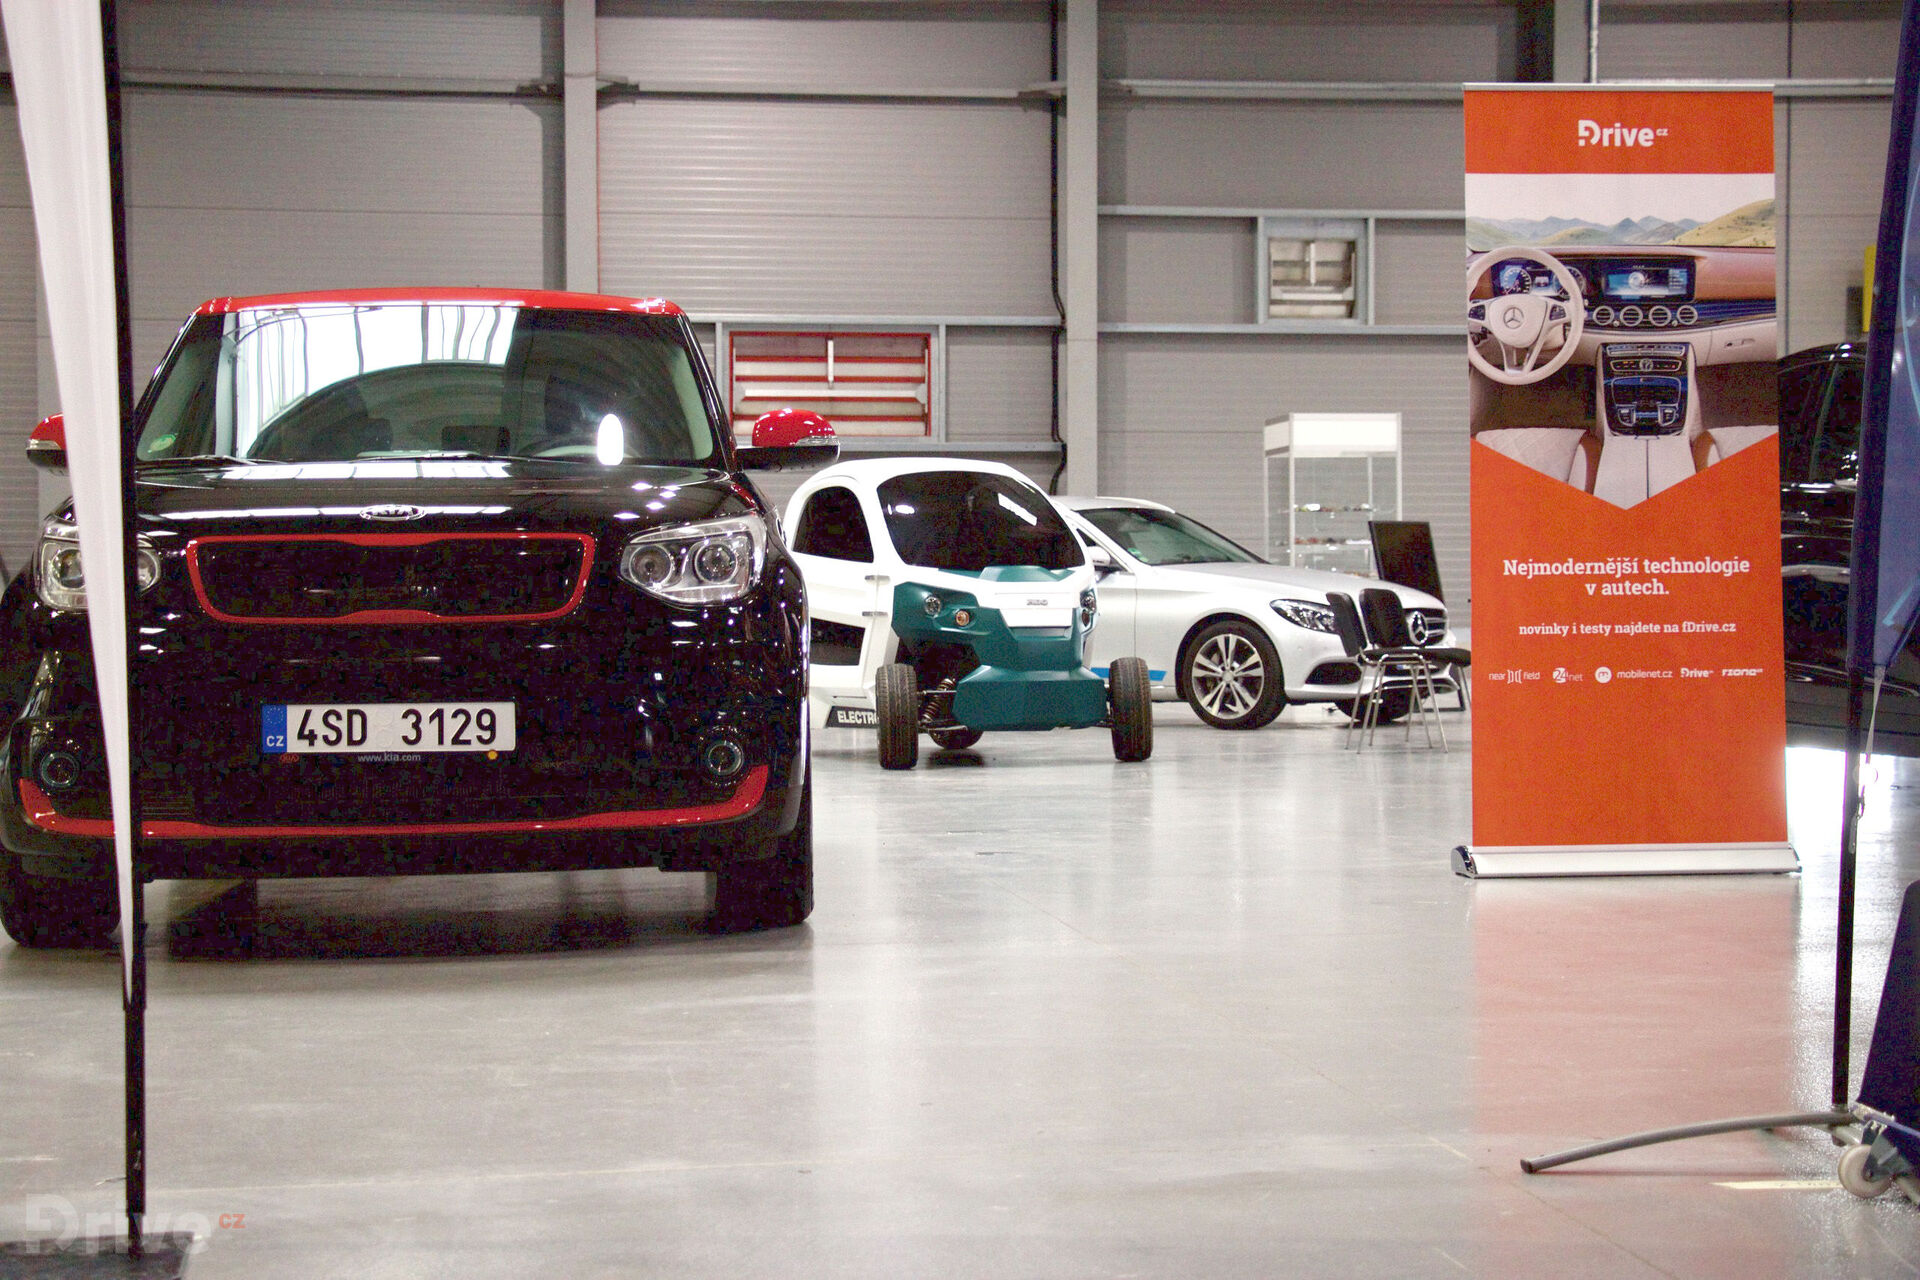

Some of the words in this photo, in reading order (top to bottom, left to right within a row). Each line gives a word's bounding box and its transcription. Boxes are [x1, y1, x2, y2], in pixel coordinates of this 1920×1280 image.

[1503, 557, 1639, 579] Nejmodernější
[1643, 556, 1750, 577] technologie
[1585, 583, 1597, 596] v
[1601, 578, 1669, 596] autech.
[1519, 622, 1569, 637] novinky
[1572, 622, 1577, 634] i
[1580, 623, 1611, 637] testy
[1614, 621, 1661, 636] najdete
[1663, 623, 1679, 634] na
[1682, 620, 1737, 633] fDrive.cz
[1616, 669, 1673, 679] mobilenet.cz
[297, 708, 368, 747] 4SD
[401, 708, 497, 746] 3129
[266, 735, 284, 747] CZ
[357, 751, 421, 762] www.kia.com
